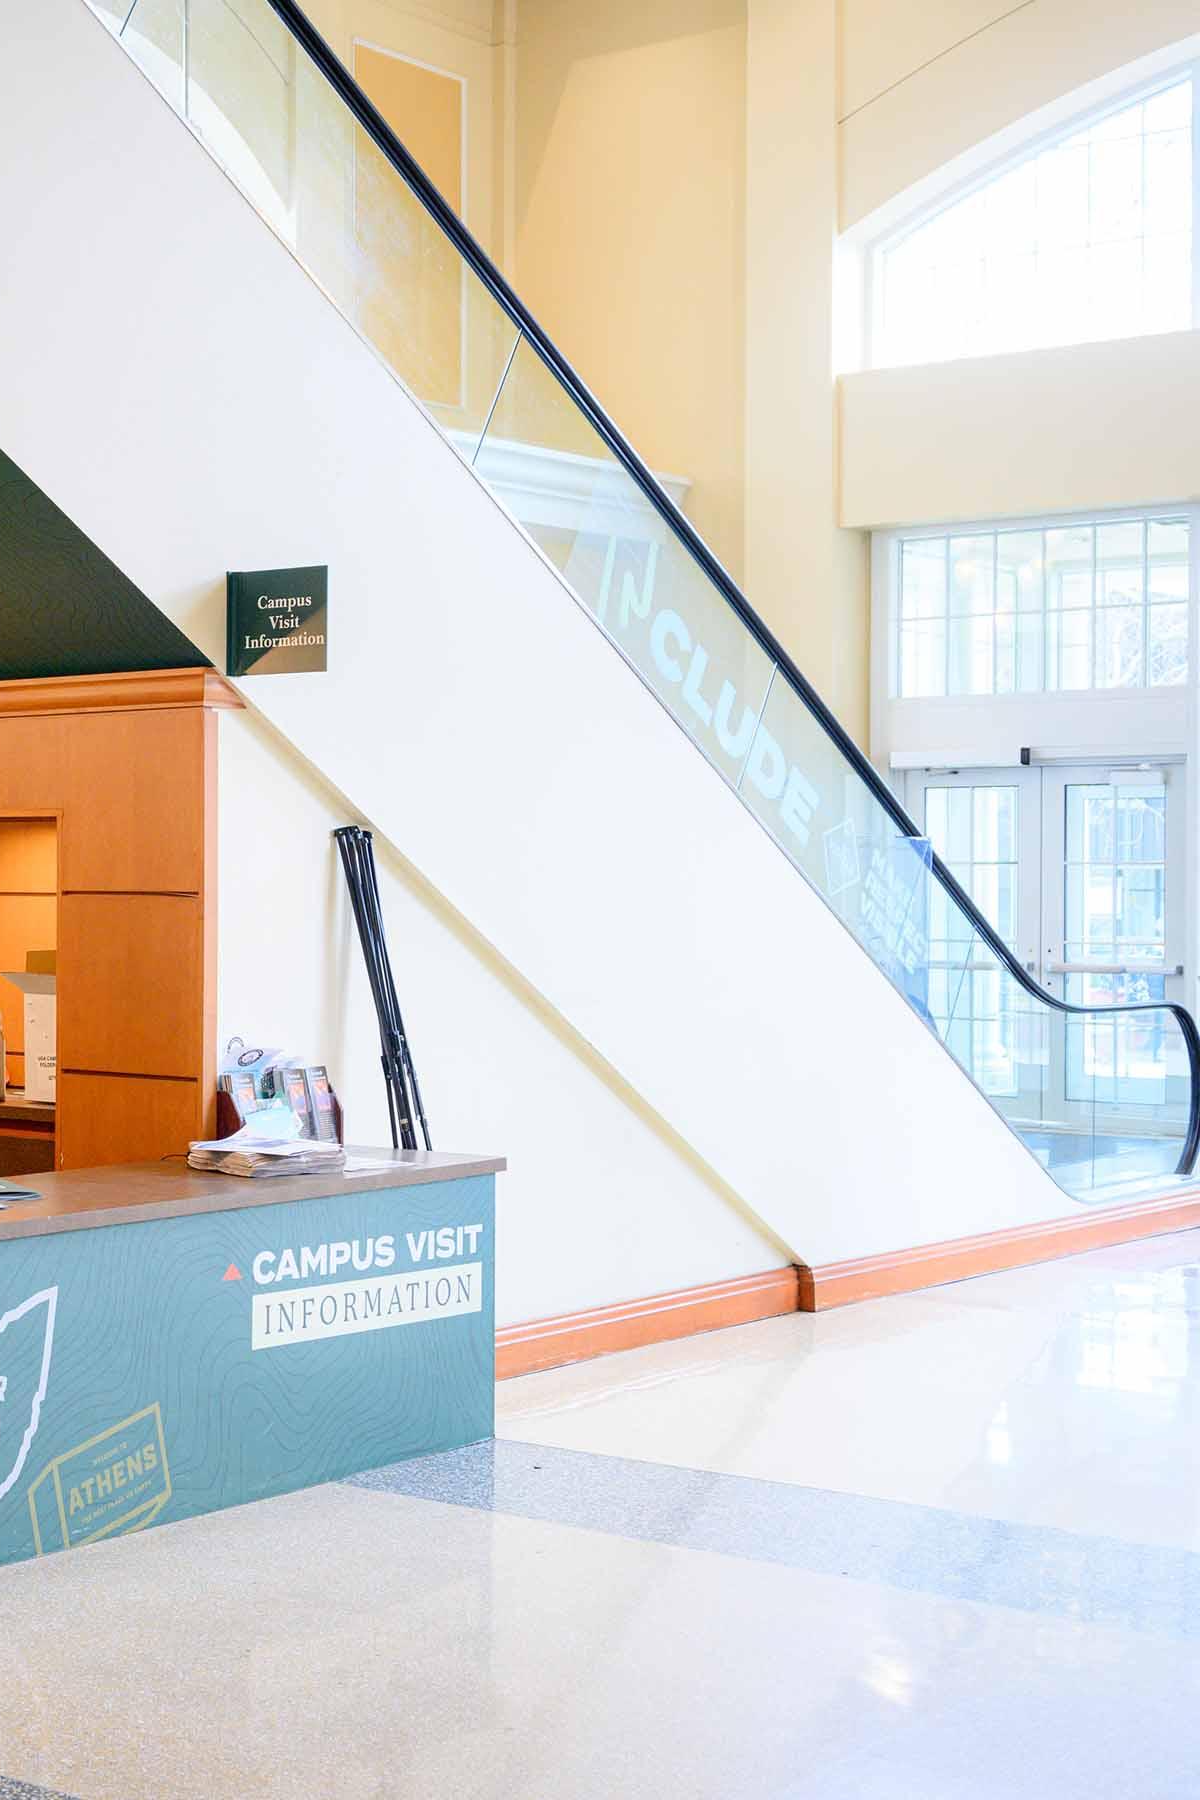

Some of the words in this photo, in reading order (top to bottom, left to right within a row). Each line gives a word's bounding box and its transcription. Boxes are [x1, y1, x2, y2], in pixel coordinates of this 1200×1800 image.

[257, 594, 312, 612] Campus
[268, 614, 301, 630] Visit
[244, 631, 326, 650] Information
[252, 1235, 396, 1285] CAMPUS
[406, 1223, 483, 1262] VISIT
[264, 1273, 472, 1335] INFORMATION
[70, 1443, 158, 1517] ATHENS
